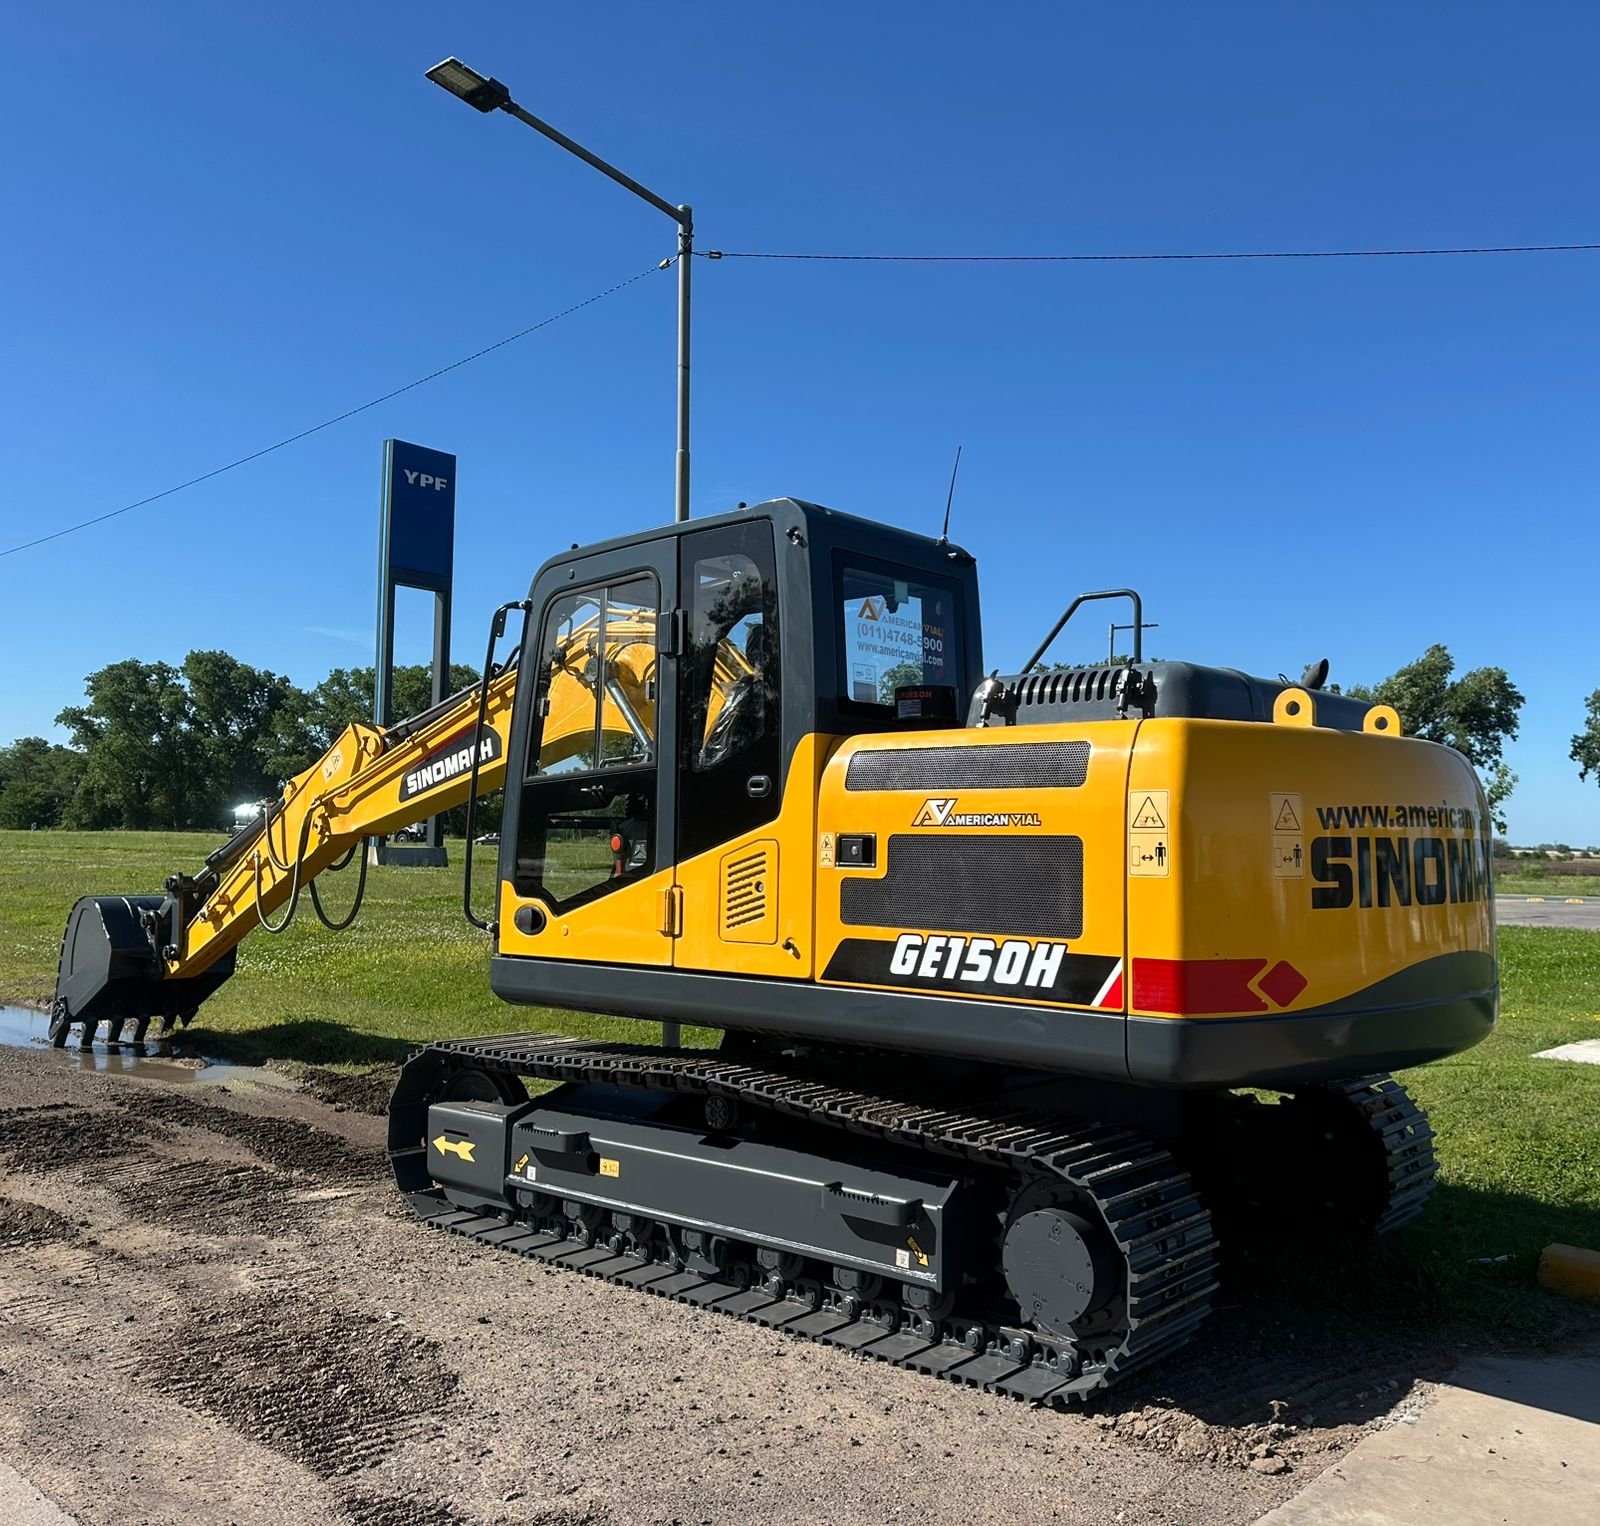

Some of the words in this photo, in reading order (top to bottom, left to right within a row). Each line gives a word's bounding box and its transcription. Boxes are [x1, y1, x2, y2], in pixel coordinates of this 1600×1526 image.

[403, 469, 448, 491] YPF
[857, 622, 943, 652] (011)4748-5900
[889, 934, 1067, 988] GE150H
